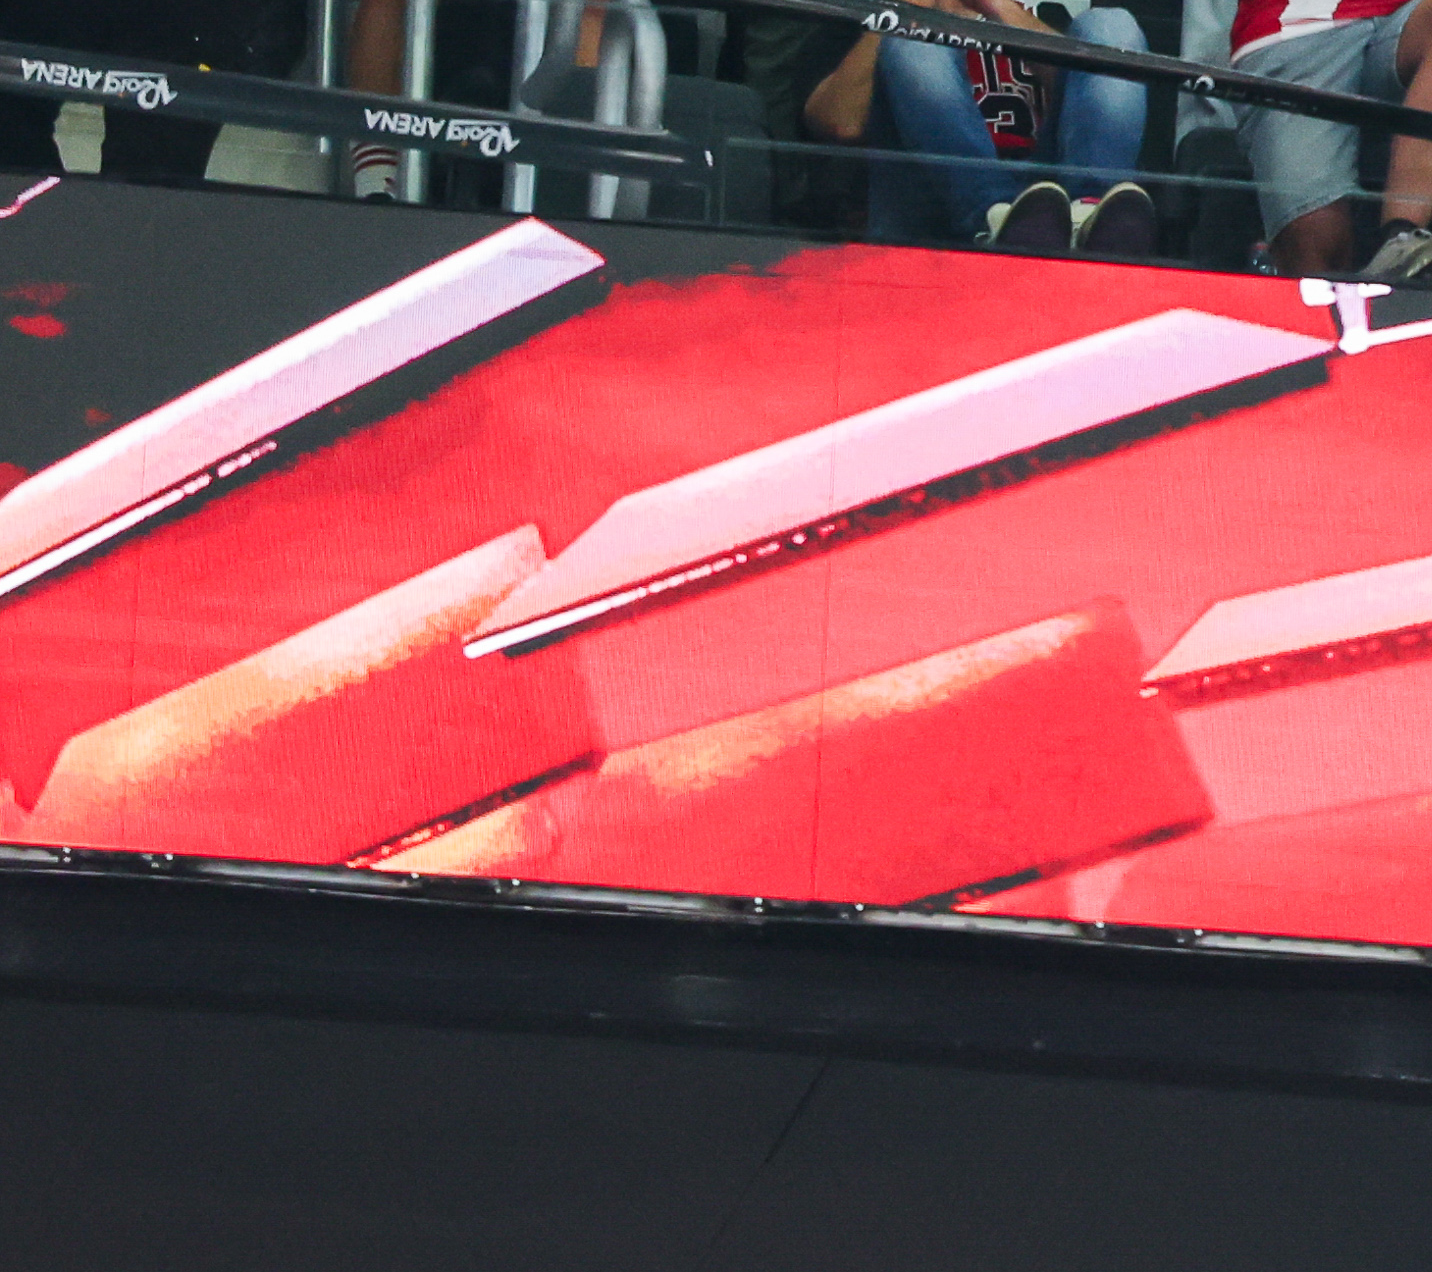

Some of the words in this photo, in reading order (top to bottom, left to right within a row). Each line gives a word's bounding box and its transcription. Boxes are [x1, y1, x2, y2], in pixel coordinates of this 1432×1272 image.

[19, 57, 104, 91] ARENA
[101, 69, 179, 111] Roig
[363, 107, 445, 139] ARENA
[444, 118, 520, 158] Roig
